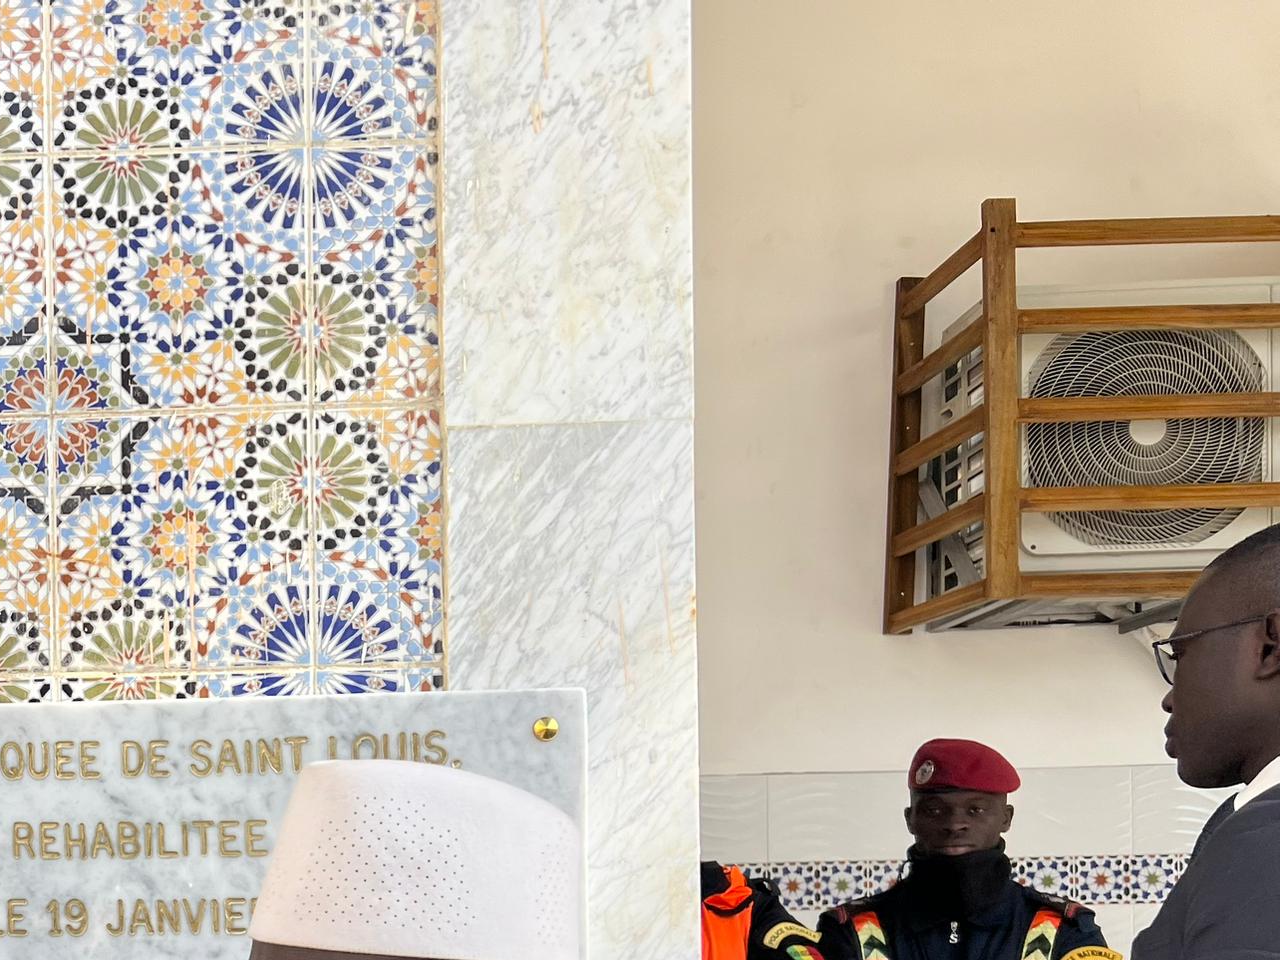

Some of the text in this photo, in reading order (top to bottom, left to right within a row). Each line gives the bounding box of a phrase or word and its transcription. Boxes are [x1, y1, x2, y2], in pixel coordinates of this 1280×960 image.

[122, 739, 171, 779] DE
[190, 736, 309, 776] SAINT
[12, 819, 269, 861] REHABILITEE
[47, 897, 89, 938] 19
[106, 896, 258, 937] JANVIE
